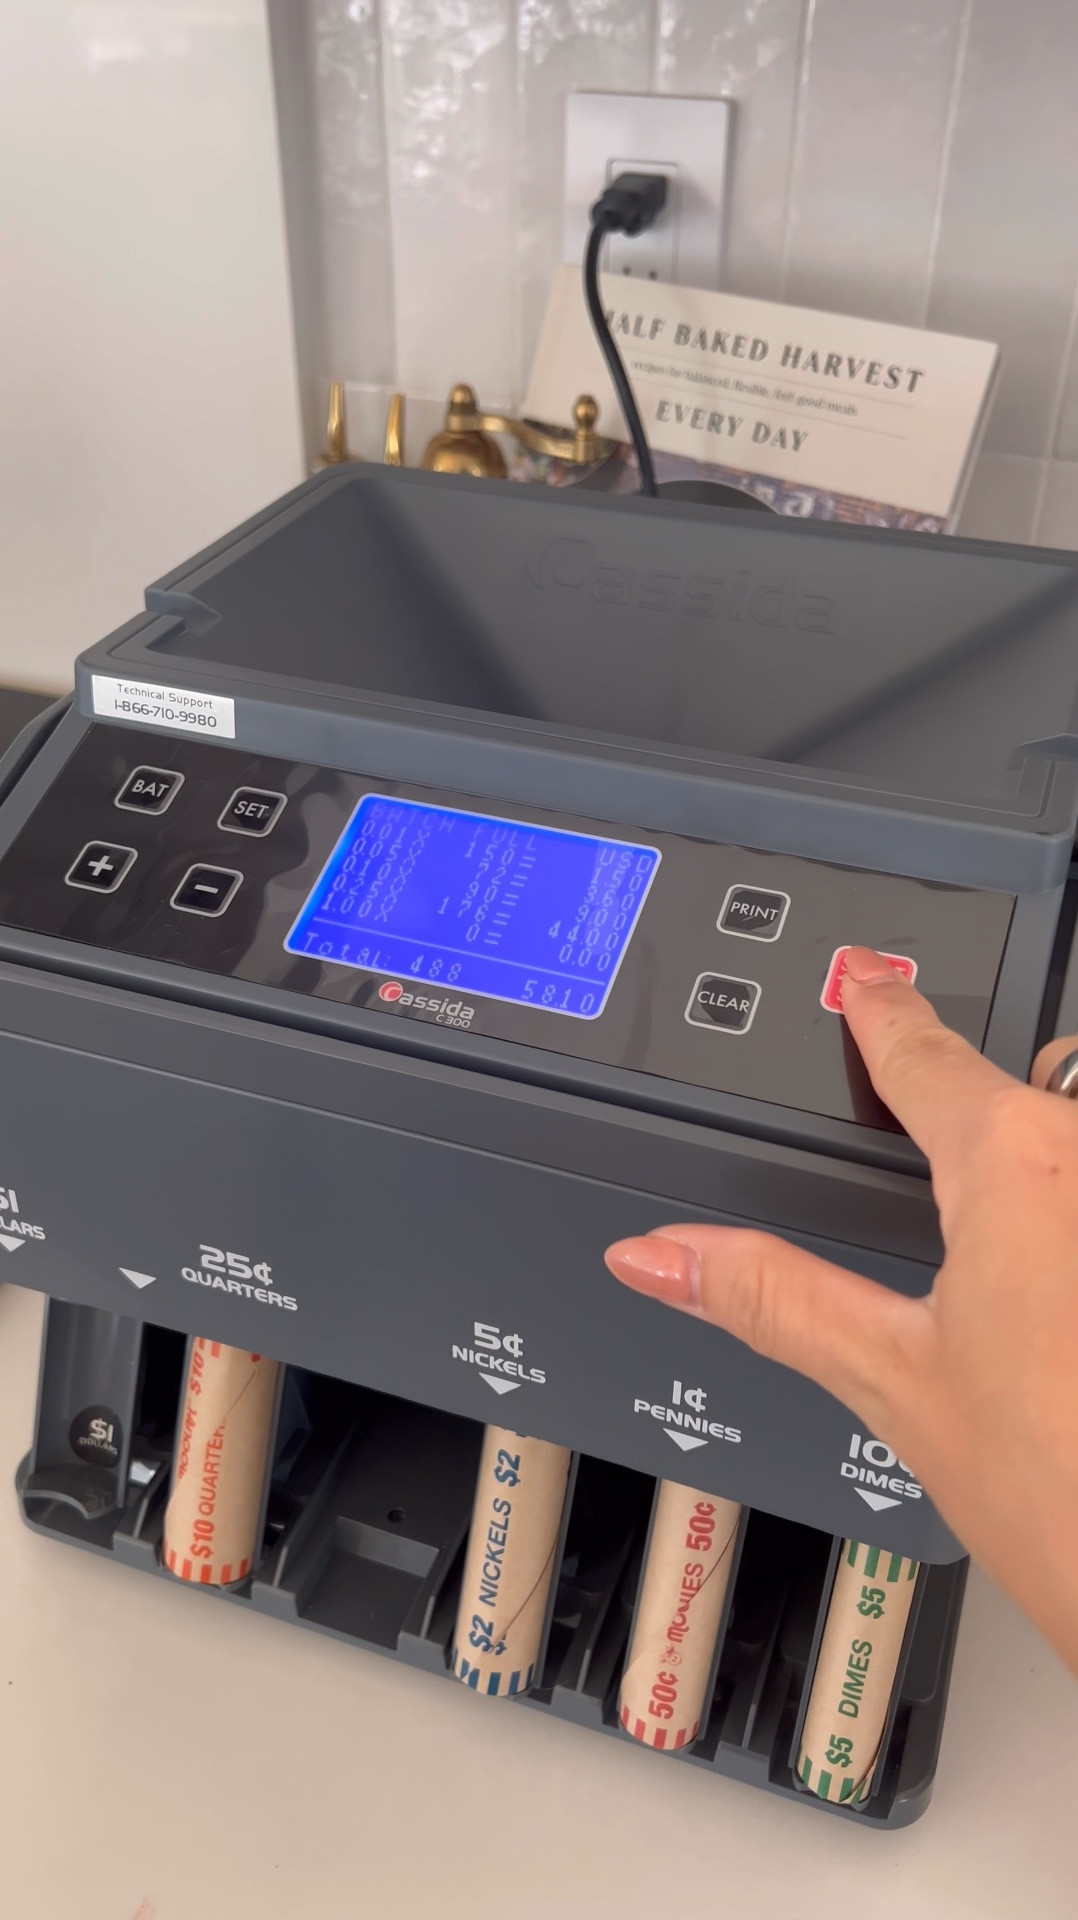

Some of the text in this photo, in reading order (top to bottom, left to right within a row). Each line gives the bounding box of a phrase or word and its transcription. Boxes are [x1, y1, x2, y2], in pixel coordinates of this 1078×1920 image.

[673, 322, 769, 362] BAKED
[780, 344, 925, 394] HARVEST
[656, 399, 809, 452] EVERY DAY
[525, 537, 839, 635] Cassida
[115, 699, 217, 728] 1-866-710-9980
[117, 683, 213, 710] Technical Support
[132, 780, 169, 798] BAT
[234, 801, 269, 818] SET
[473, 823, 536, 851] FULL
[600, 847, 652, 873] USD
[591, 867, 643, 892] 1.50
[575, 904, 627, 931] 9.00
[730, 901, 778, 921] PRINT
[548, 920, 619, 951] 44.00
[303, 932, 595, 1013] Total: 488 58.10
[559, 944, 611, 971] 0.00
[379, 981, 475, 1020] Cassida
[697, 991, 750, 1013] CLEAR
[0, 1216, 46, 1240] LARS
[200, 1244, 273, 1285] 25¢
[181, 1267, 298, 1311] QUARTERS
[474, 1322, 523, 1357] 5¢
[190, 1350, 204, 1395] $10
[452, 1345, 546, 1384] NICKELS
[671, 1380, 707, 1412] 1¢
[90, 1417, 114, 1442] $1
[634, 1398, 742, 1443] PENNIES
[494, 1448, 521, 1487] $2
[849, 1433, 915, 1478] 10
[840, 1462, 922, 1498] DIMES
[190, 1518, 215, 1559] $10
[479, 1497, 512, 1607] NICKELS
[648, 1671, 679, 1720] 50¢
[685, 1501, 717, 1551] 50¢
[469, 1614, 494, 1653] $2
[825, 1584, 886, 1768] $5 DIMES $5
